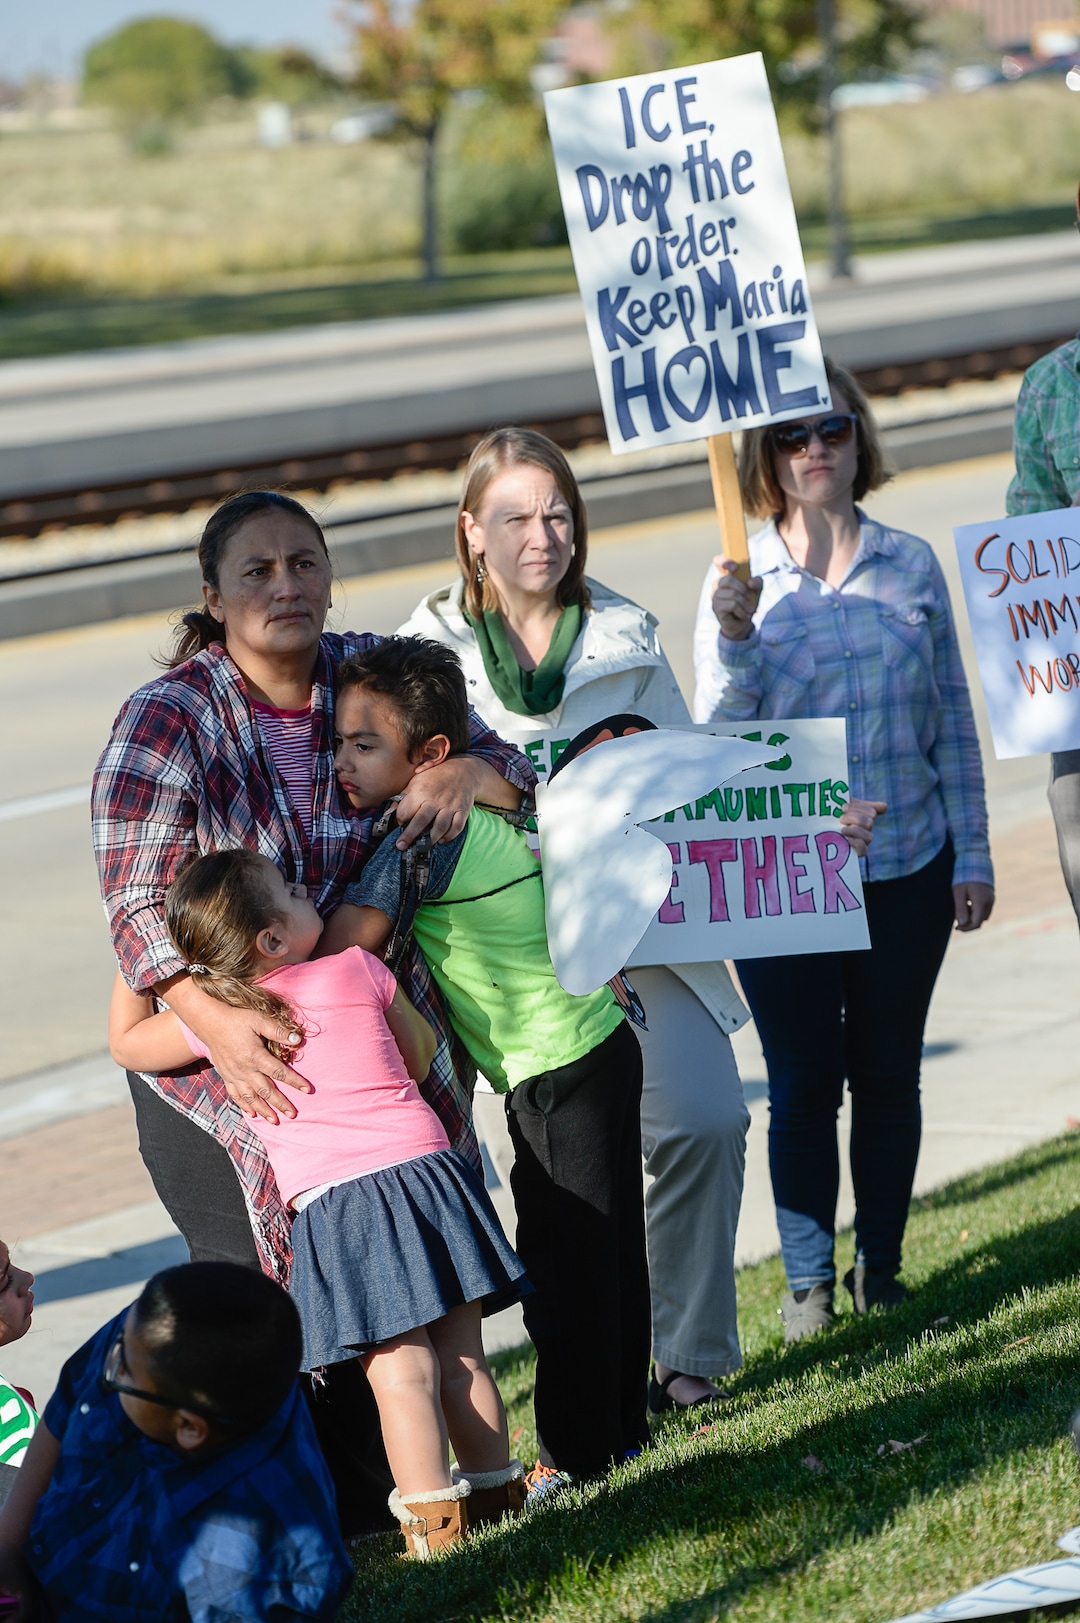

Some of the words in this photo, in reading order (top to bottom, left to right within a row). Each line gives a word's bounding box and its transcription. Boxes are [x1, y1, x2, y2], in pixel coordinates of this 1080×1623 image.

[618, 77, 715, 149] ICE,
[575, 163, 672, 234] Drop
[682, 139, 755, 204] the
[630, 214, 739, 280] order.
[597, 284, 697, 352] Keep
[697, 259, 808, 331] Maria
[1006, 593, 1080, 642] IMM
[648, 779, 849, 823] MUNITIES
[659, 831, 862, 924] ETHER
